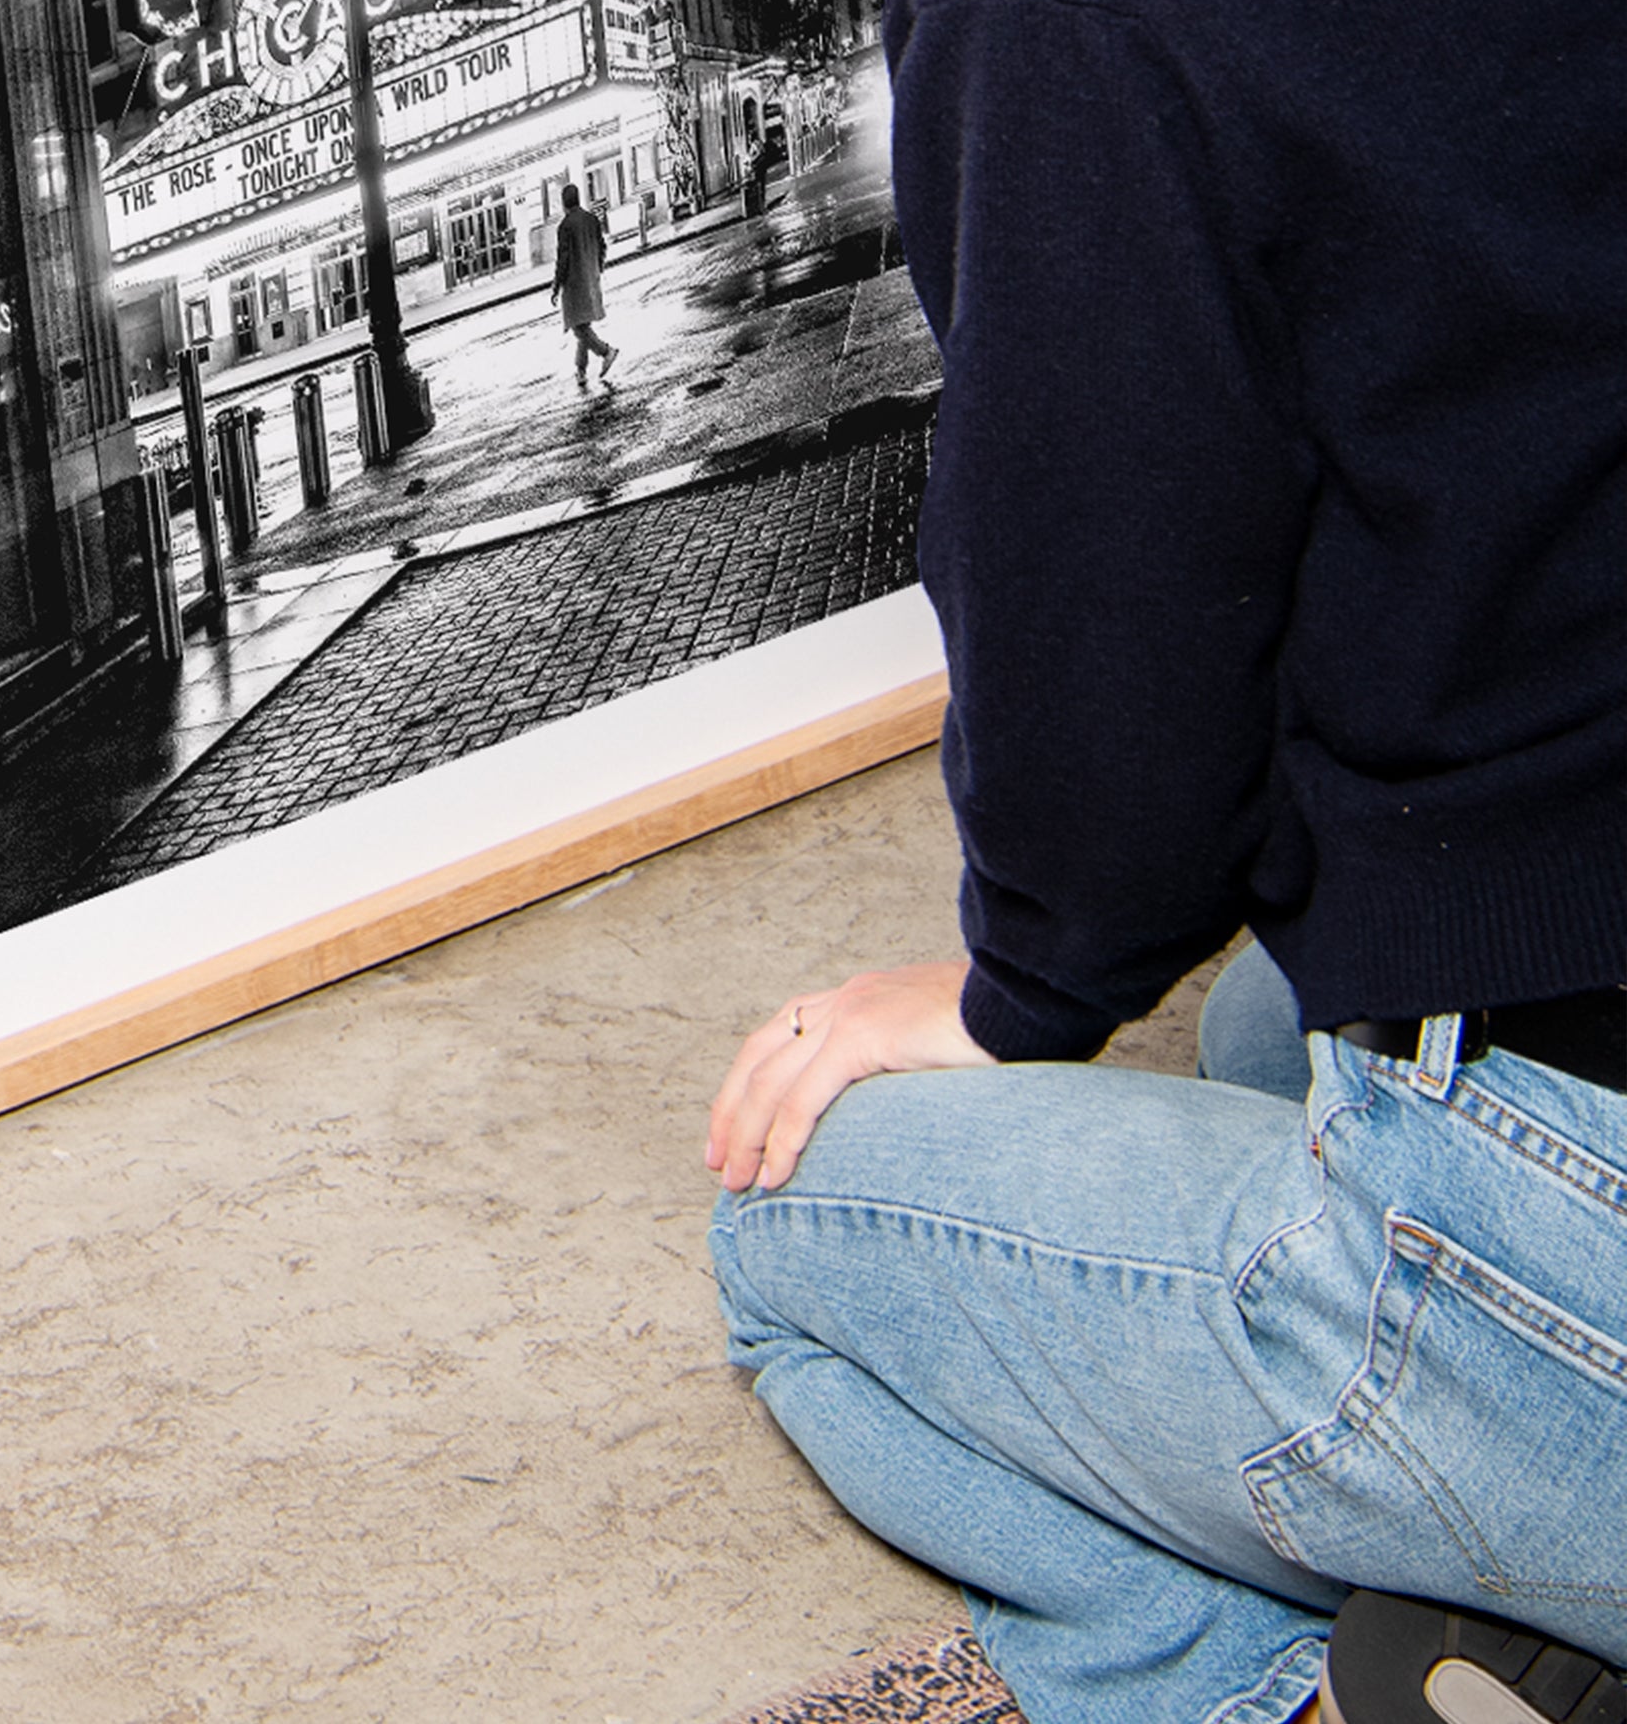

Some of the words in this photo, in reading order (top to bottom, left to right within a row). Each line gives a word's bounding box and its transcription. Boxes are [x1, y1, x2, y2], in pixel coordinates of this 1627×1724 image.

[118, 180, 157, 216] THE
[169, 157, 216, 197] ROSE
[241, 128, 293, 169] ONCE
[390, 69, 448, 112] WRLD
[455, 43, 512, 87] TOUR
[237, 147, 319, 200] TONIGHT
